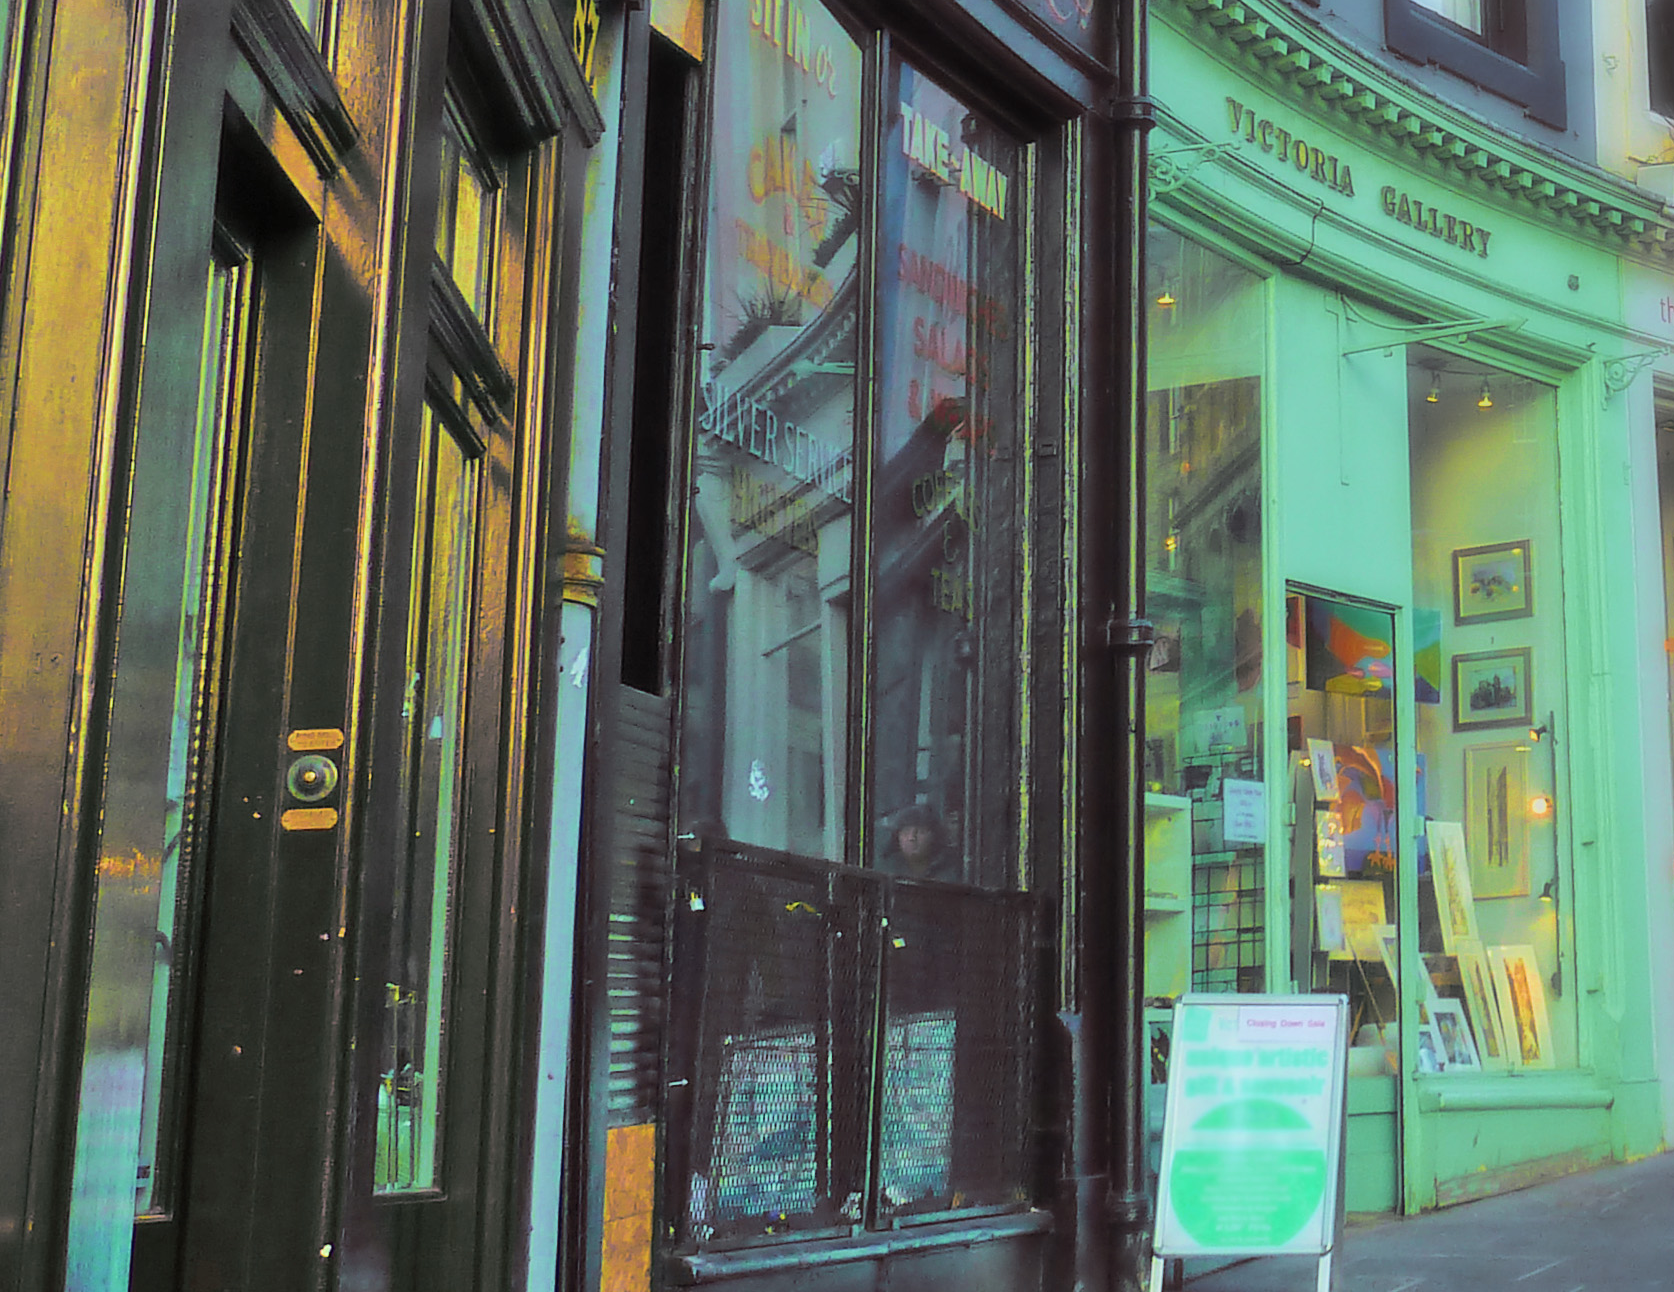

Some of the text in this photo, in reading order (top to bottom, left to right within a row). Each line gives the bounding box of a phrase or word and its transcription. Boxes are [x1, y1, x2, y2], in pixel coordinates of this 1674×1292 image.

[787, 0, 811, 73] IN
[1226, 96, 1491, 258] VICTORIA GALLERY
[699, 381, 778, 467] SILVER
[1246, 1018, 1277, 1029] Closing
[1280, 1019, 1304, 1028] Down
